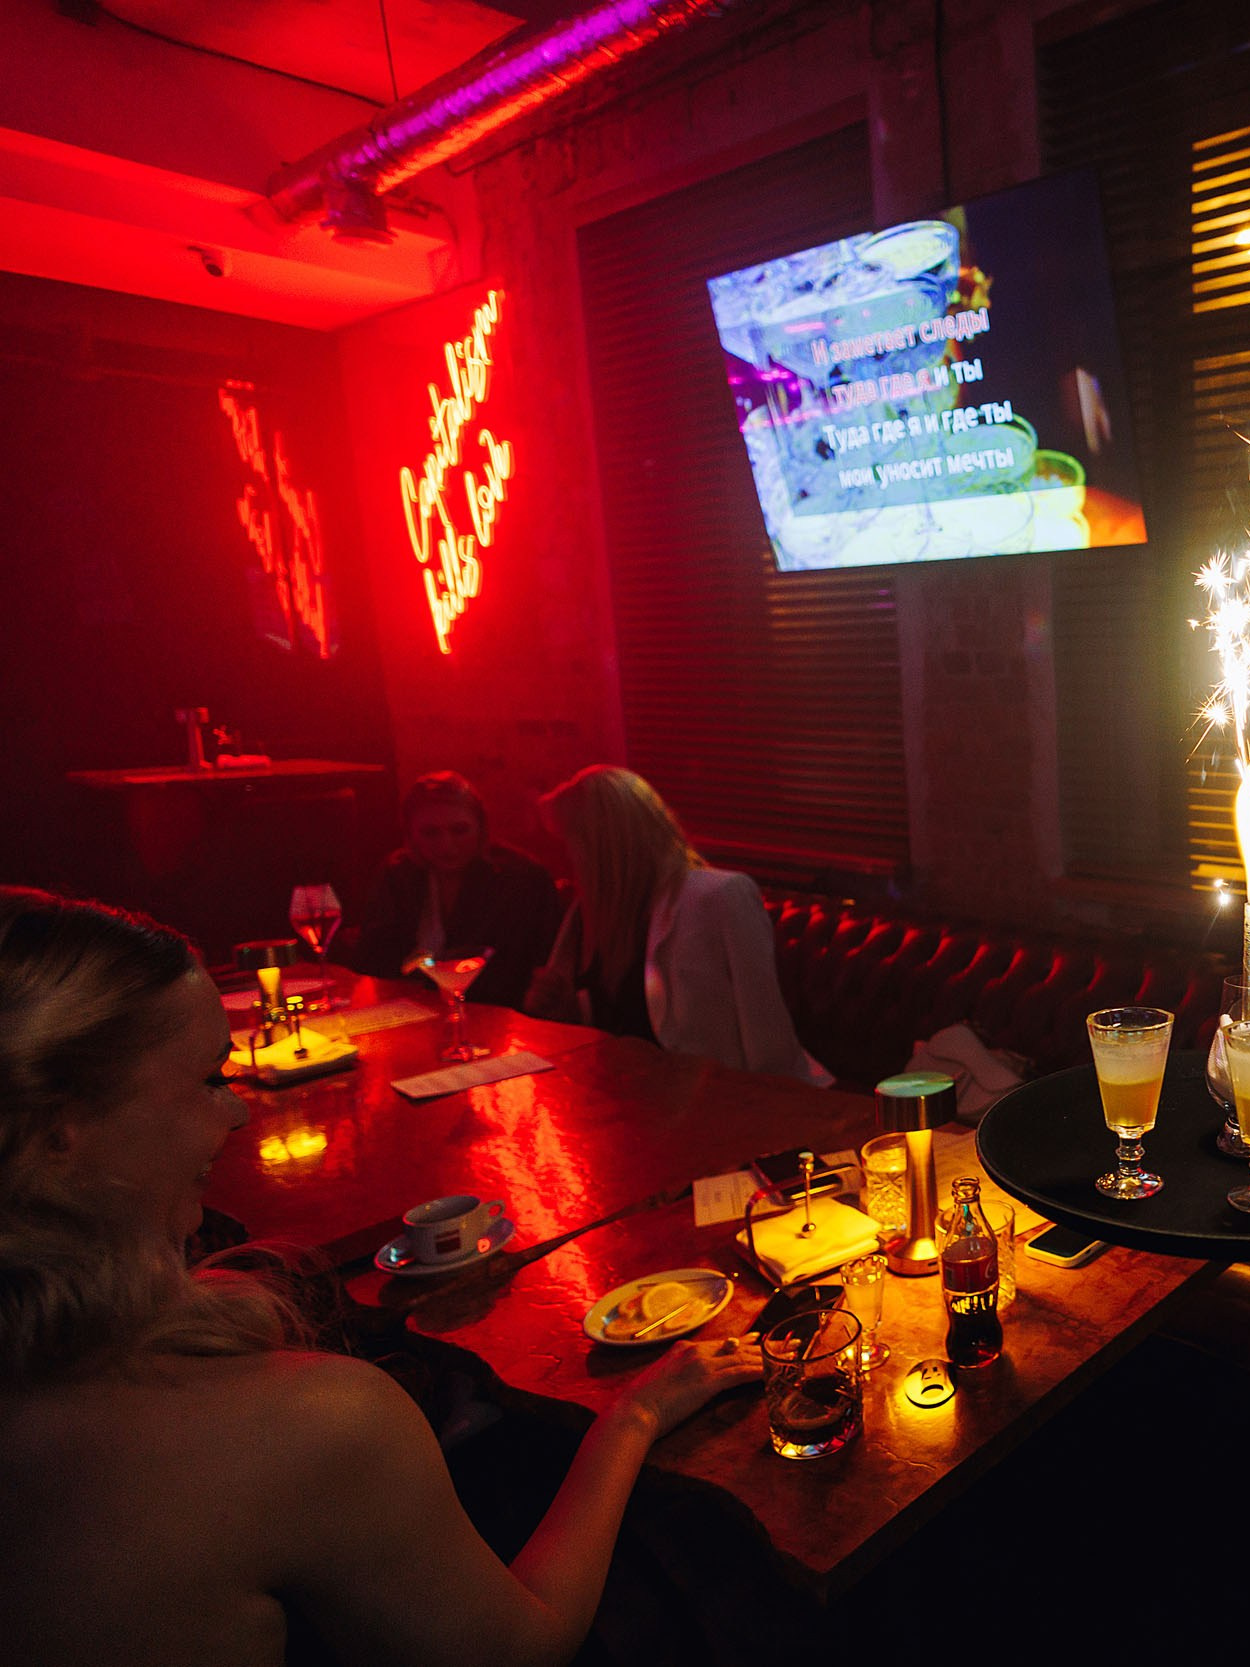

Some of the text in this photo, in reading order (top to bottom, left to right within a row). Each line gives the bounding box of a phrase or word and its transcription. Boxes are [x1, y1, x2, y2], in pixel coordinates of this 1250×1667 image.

[811, 307, 990, 366] И заметает следы
[832, 358, 984, 406] туда где я и ты
[823, 400, 1013, 454] Туда где я и где ты
[875, 457, 943, 490] уносит
[946, 447, 1015, 474] мечты
